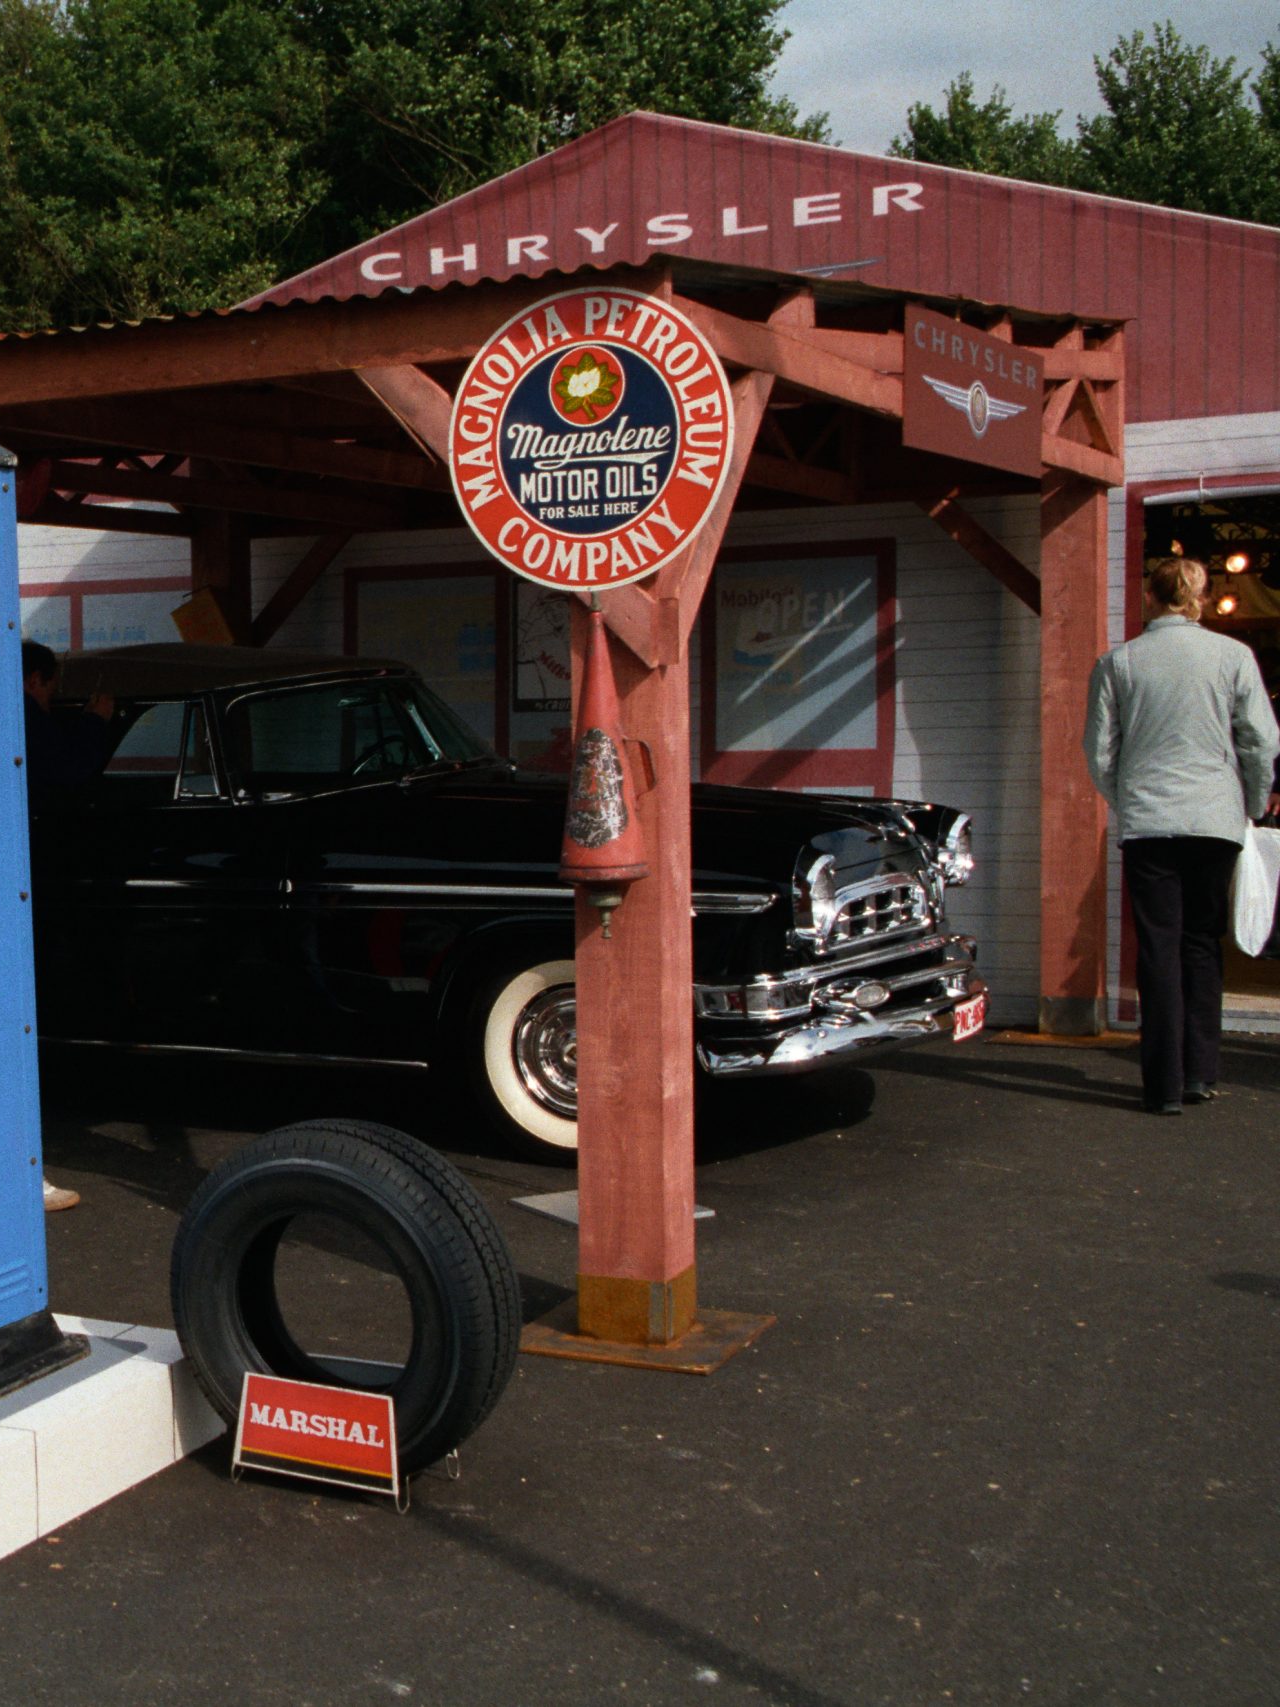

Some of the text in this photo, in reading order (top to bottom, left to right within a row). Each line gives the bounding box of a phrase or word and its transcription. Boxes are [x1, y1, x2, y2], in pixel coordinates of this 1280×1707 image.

[360, 182, 925, 281] CHRYSLER
[914, 321, 1036, 390] CHRYSLER
[458, 297, 723, 581] MAGNOLIA PETROLEUM COMPANY
[507, 416, 671, 467] Magnolene
[520, 464, 658, 504] MOTOR OILS
[539, 502, 638, 520] FOR SALE HERE
[250, 1402, 384, 1448] MARSHAL
